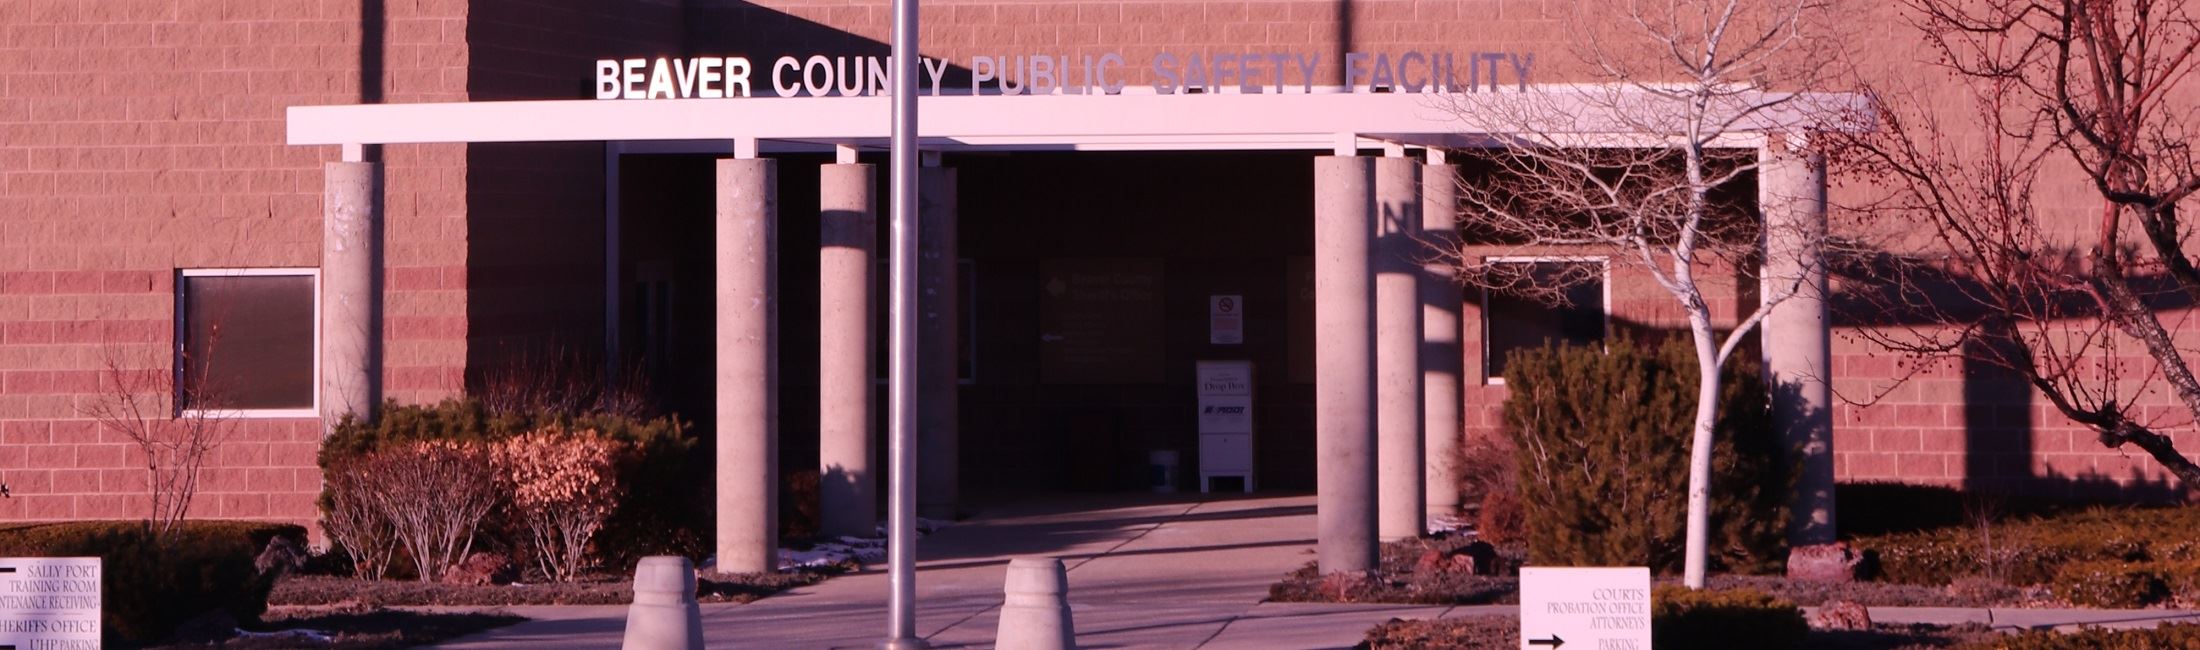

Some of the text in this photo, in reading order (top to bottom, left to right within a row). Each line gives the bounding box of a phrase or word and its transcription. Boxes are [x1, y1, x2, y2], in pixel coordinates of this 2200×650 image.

[597, 51, 1535, 99] BEAVER COUNY PUBLIC SAFETY FACILITY
[27, 564, 97, 578] SALLY PORT
[9, 580, 97, 593] TRAINING ROOM
[1592, 588, 1644, 601] COURTS
[49, 595, 97, 609] RECEIVING
[1547, 602, 1645, 614] PROBATION OFFICE
[51, 620, 97, 632] OFFICE
[1590, 616, 1645, 630] ATTORNEYS
[30, 638, 98, 650] UHP PARKING
[1598, 638, 1639, 650] PARKING
